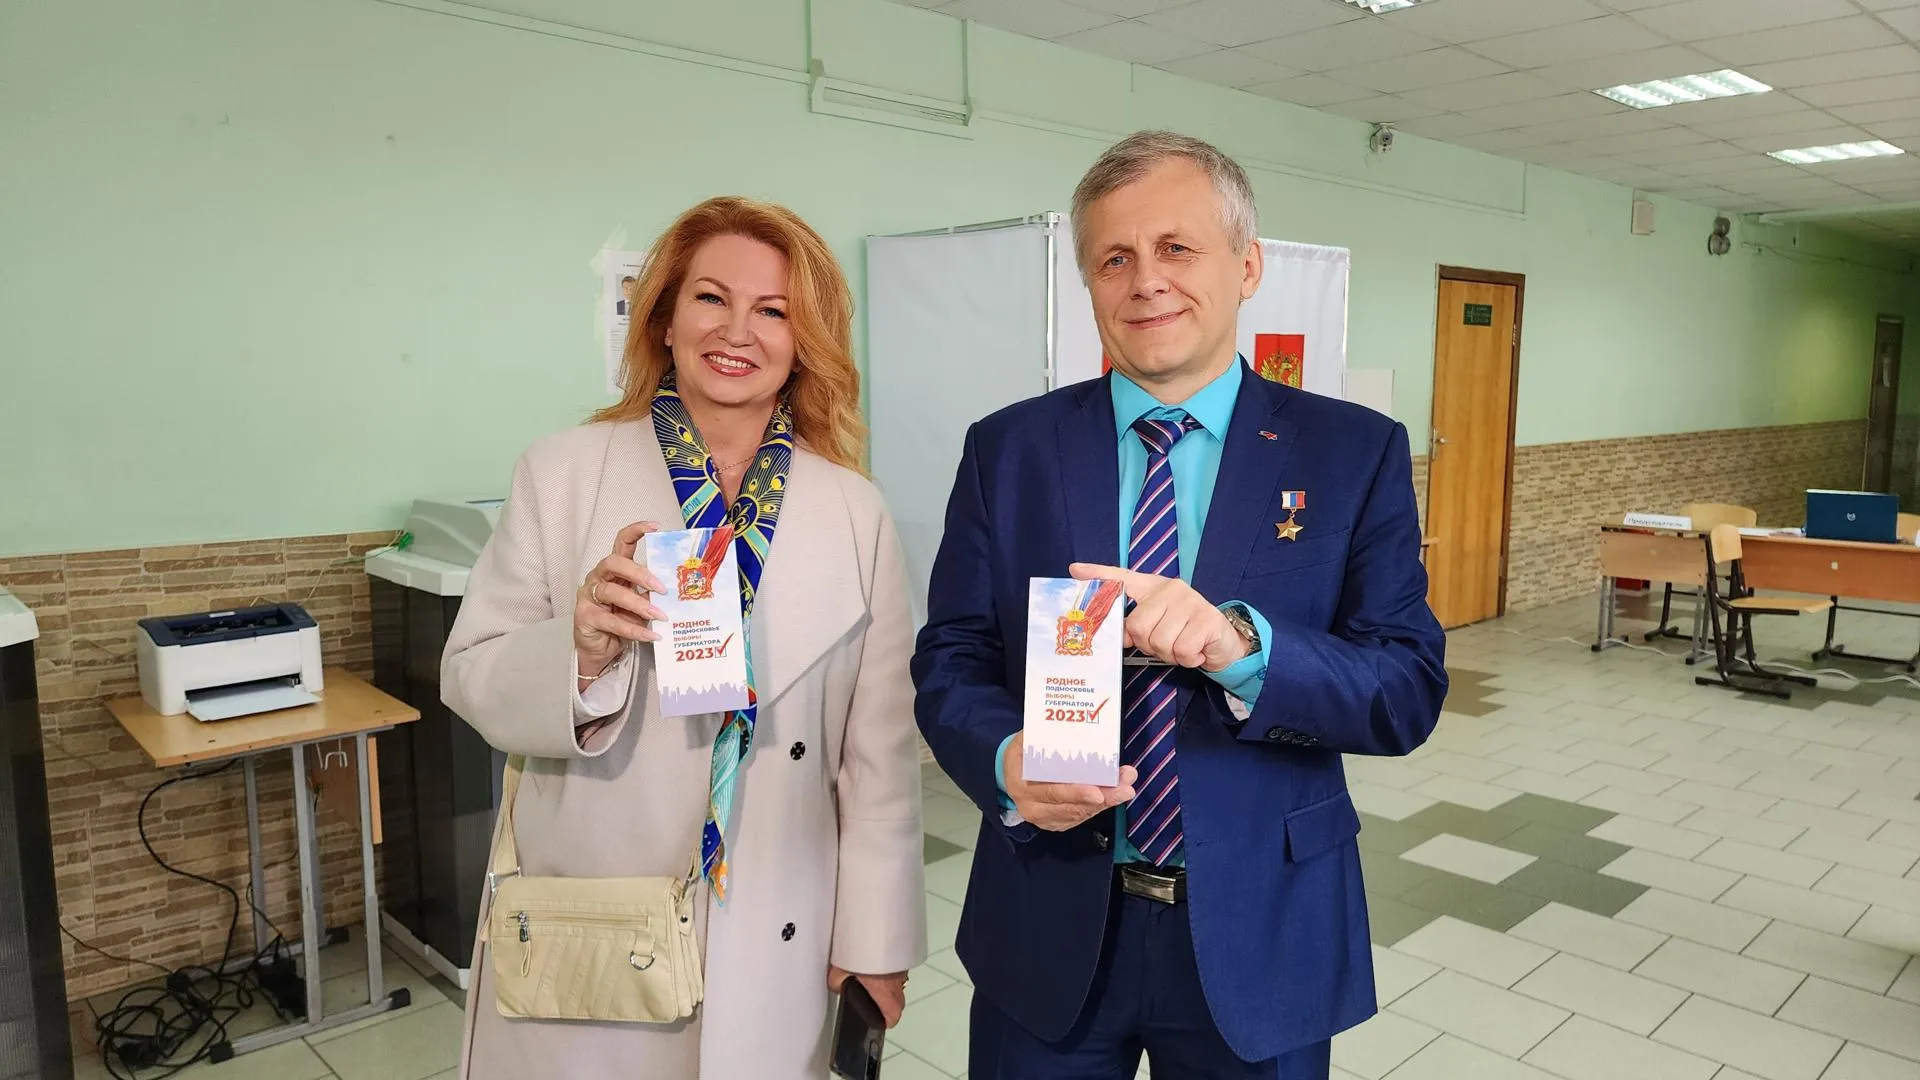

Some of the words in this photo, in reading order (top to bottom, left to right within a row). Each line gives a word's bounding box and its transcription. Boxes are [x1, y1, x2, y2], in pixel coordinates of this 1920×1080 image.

[672, 619, 711, 629] РОДНОЕ
[672, 625, 721, 636] ПОДМОСКОВЬЕ
[673, 634, 702, 642] ВЫБОРЫ
[673, 639, 721, 649] ГУБЕРНАТОРА
[675, 647, 714, 662] 2023
[1046, 677, 1087, 686] РОДНОЕ
[1045, 685, 1095, 693] ПОДМОСКОВЬЕ
[1045, 699, 1095, 708] ГУБЕРНАТОРА
[1045, 708, 1086, 722] 2023
